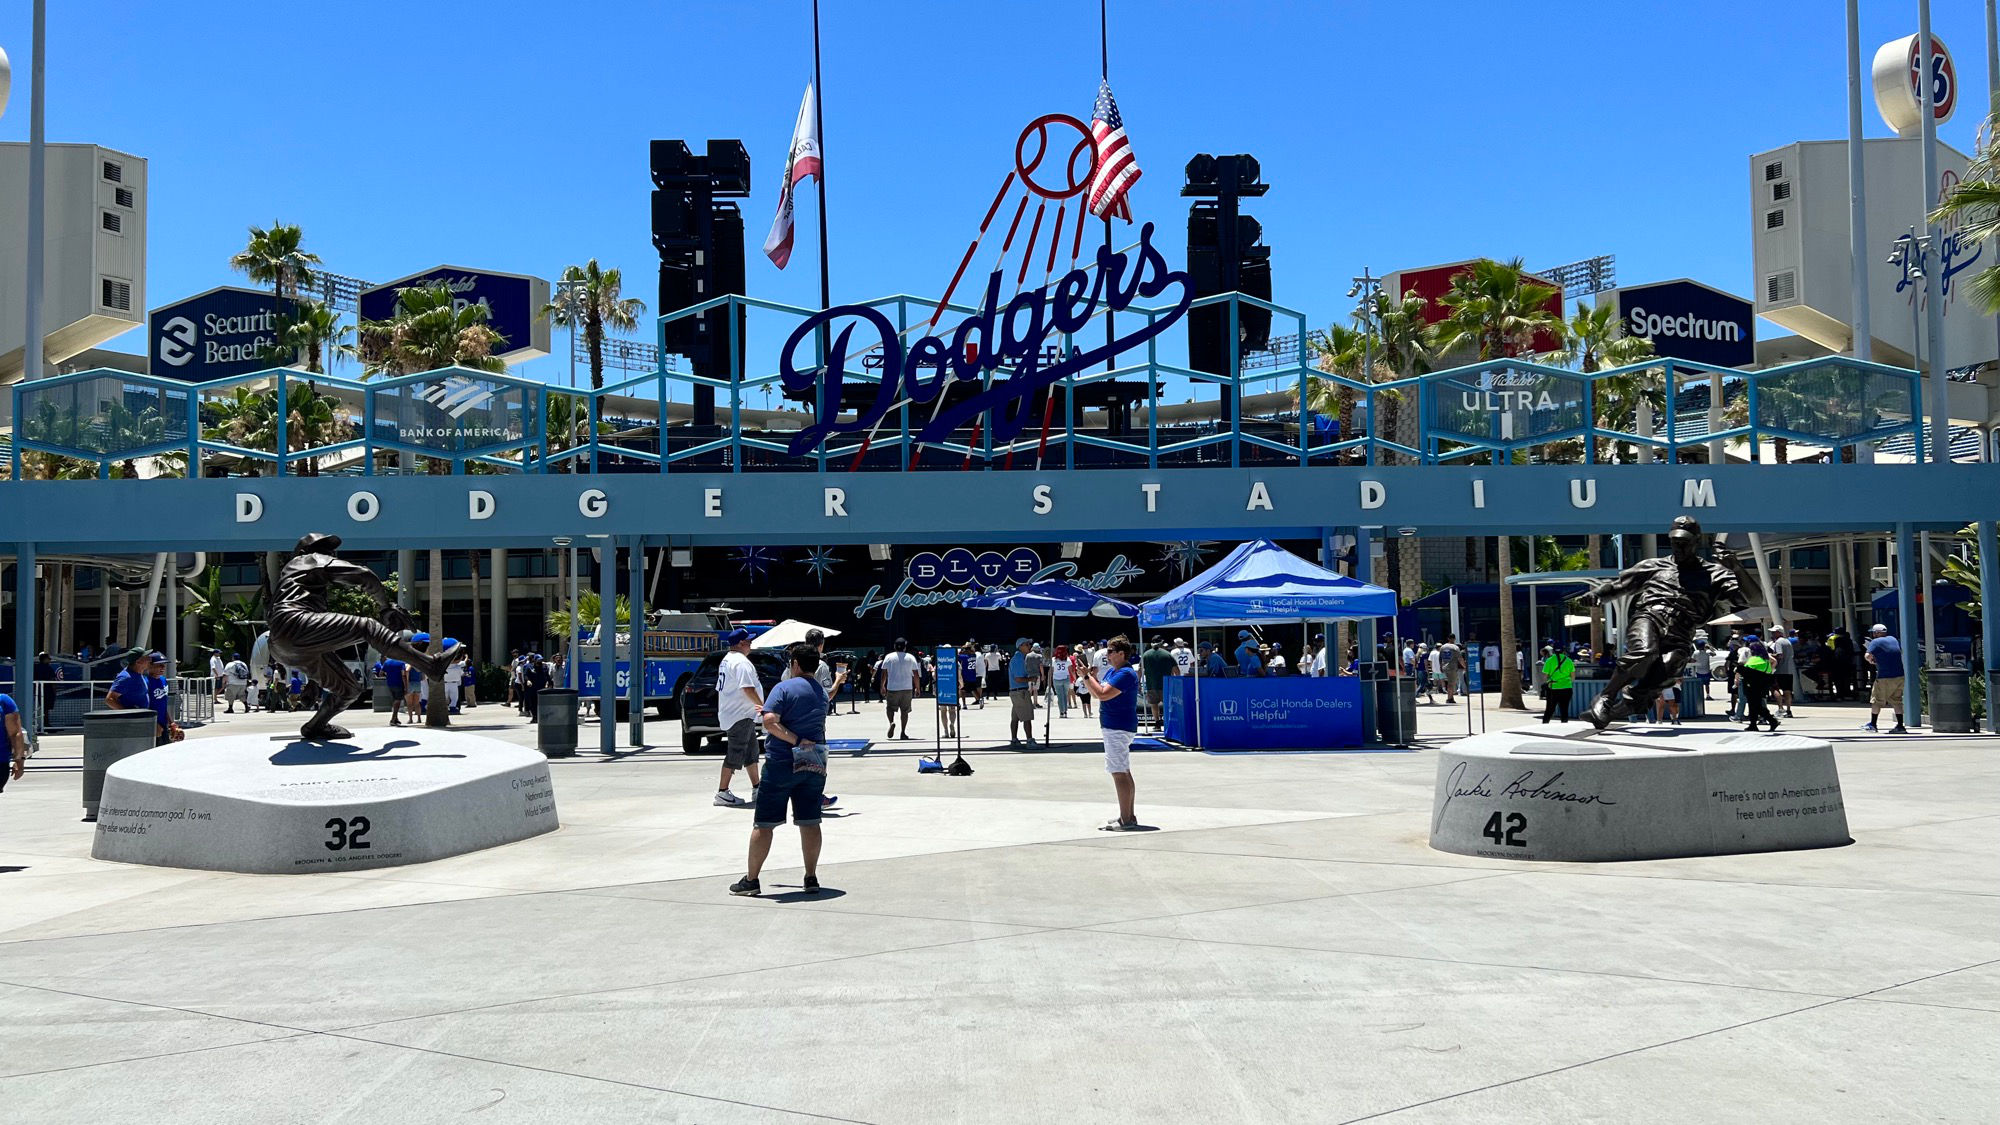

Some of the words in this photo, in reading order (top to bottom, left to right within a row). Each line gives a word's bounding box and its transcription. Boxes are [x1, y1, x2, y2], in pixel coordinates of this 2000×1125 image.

[1631, 307, 1739, 342] Spectrum
[779, 221, 1196, 457] Dodgers
[1475, 372, 1538, 387] Michelob
[1462, 390, 1555, 411] ULTRA
[400, 428, 434, 437] BANK
[437, 428, 452, 437] OF
[454, 427, 510, 437] AMERICA
[236, 487, 848, 522] DODGER
[1033, 479, 1717, 515] STADIUM
[918, 559, 1032, 577] BLUE
[1178, 656, 1188, 665] 22
[585, 671, 595, 687] LA
[658, 668, 666, 685] LA
[1250, 699, 1279, 709] SoCal
[1281, 699, 1313, 709] Honda
[1315, 699, 1352, 708] Dealers
[1251, 710, 1287, 721] Helpful
[511, 779, 519, 791] Cy
[519, 778, 534, 788] Young
[1501, 770, 1616, 806] Robinson
[1752, 790, 1766, 801] not
[1768, 791, 1779, 800] an
[1781, 786, 1820, 798] American
[109, 806, 128, 817] interest
[128, 806, 141, 818] and
[141, 809, 168, 819] common
[188, 808, 196, 820] To
[1736, 807, 1754, 820] free
[1756, 805, 1774, 818] until
[1776, 806, 1800, 819] every
[1802, 805, 1817, 815] one
[107, 821, 118, 833] else
[118, 821, 138, 834] would
[325, 816, 370, 851] 32
[1483, 811, 1527, 847] 42
